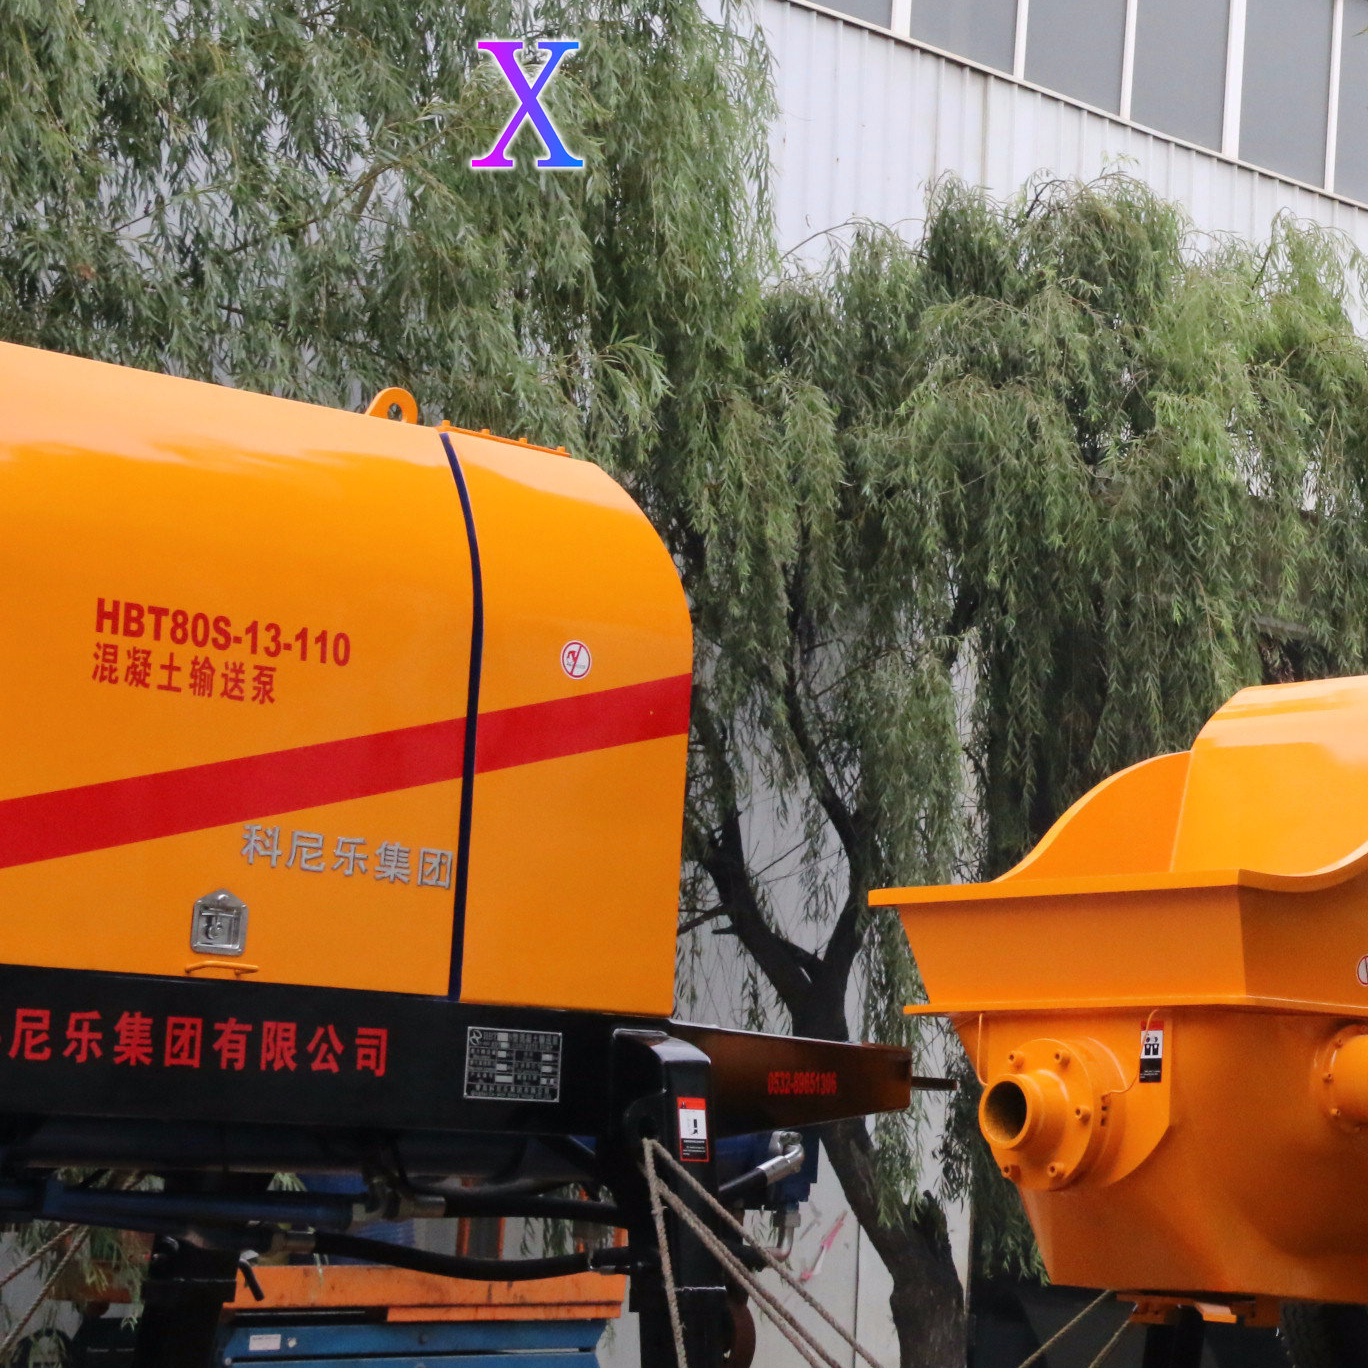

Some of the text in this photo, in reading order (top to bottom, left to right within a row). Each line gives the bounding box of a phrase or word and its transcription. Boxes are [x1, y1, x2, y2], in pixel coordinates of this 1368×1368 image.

[96, 597, 351, 668] HBT80S-13-110
[91, 641, 277, 705] 混凝土输送泵
[241, 824, 454, 889] 科尼乐集团
[8, 1007, 389, 1077] 尼乐集团有限公司
